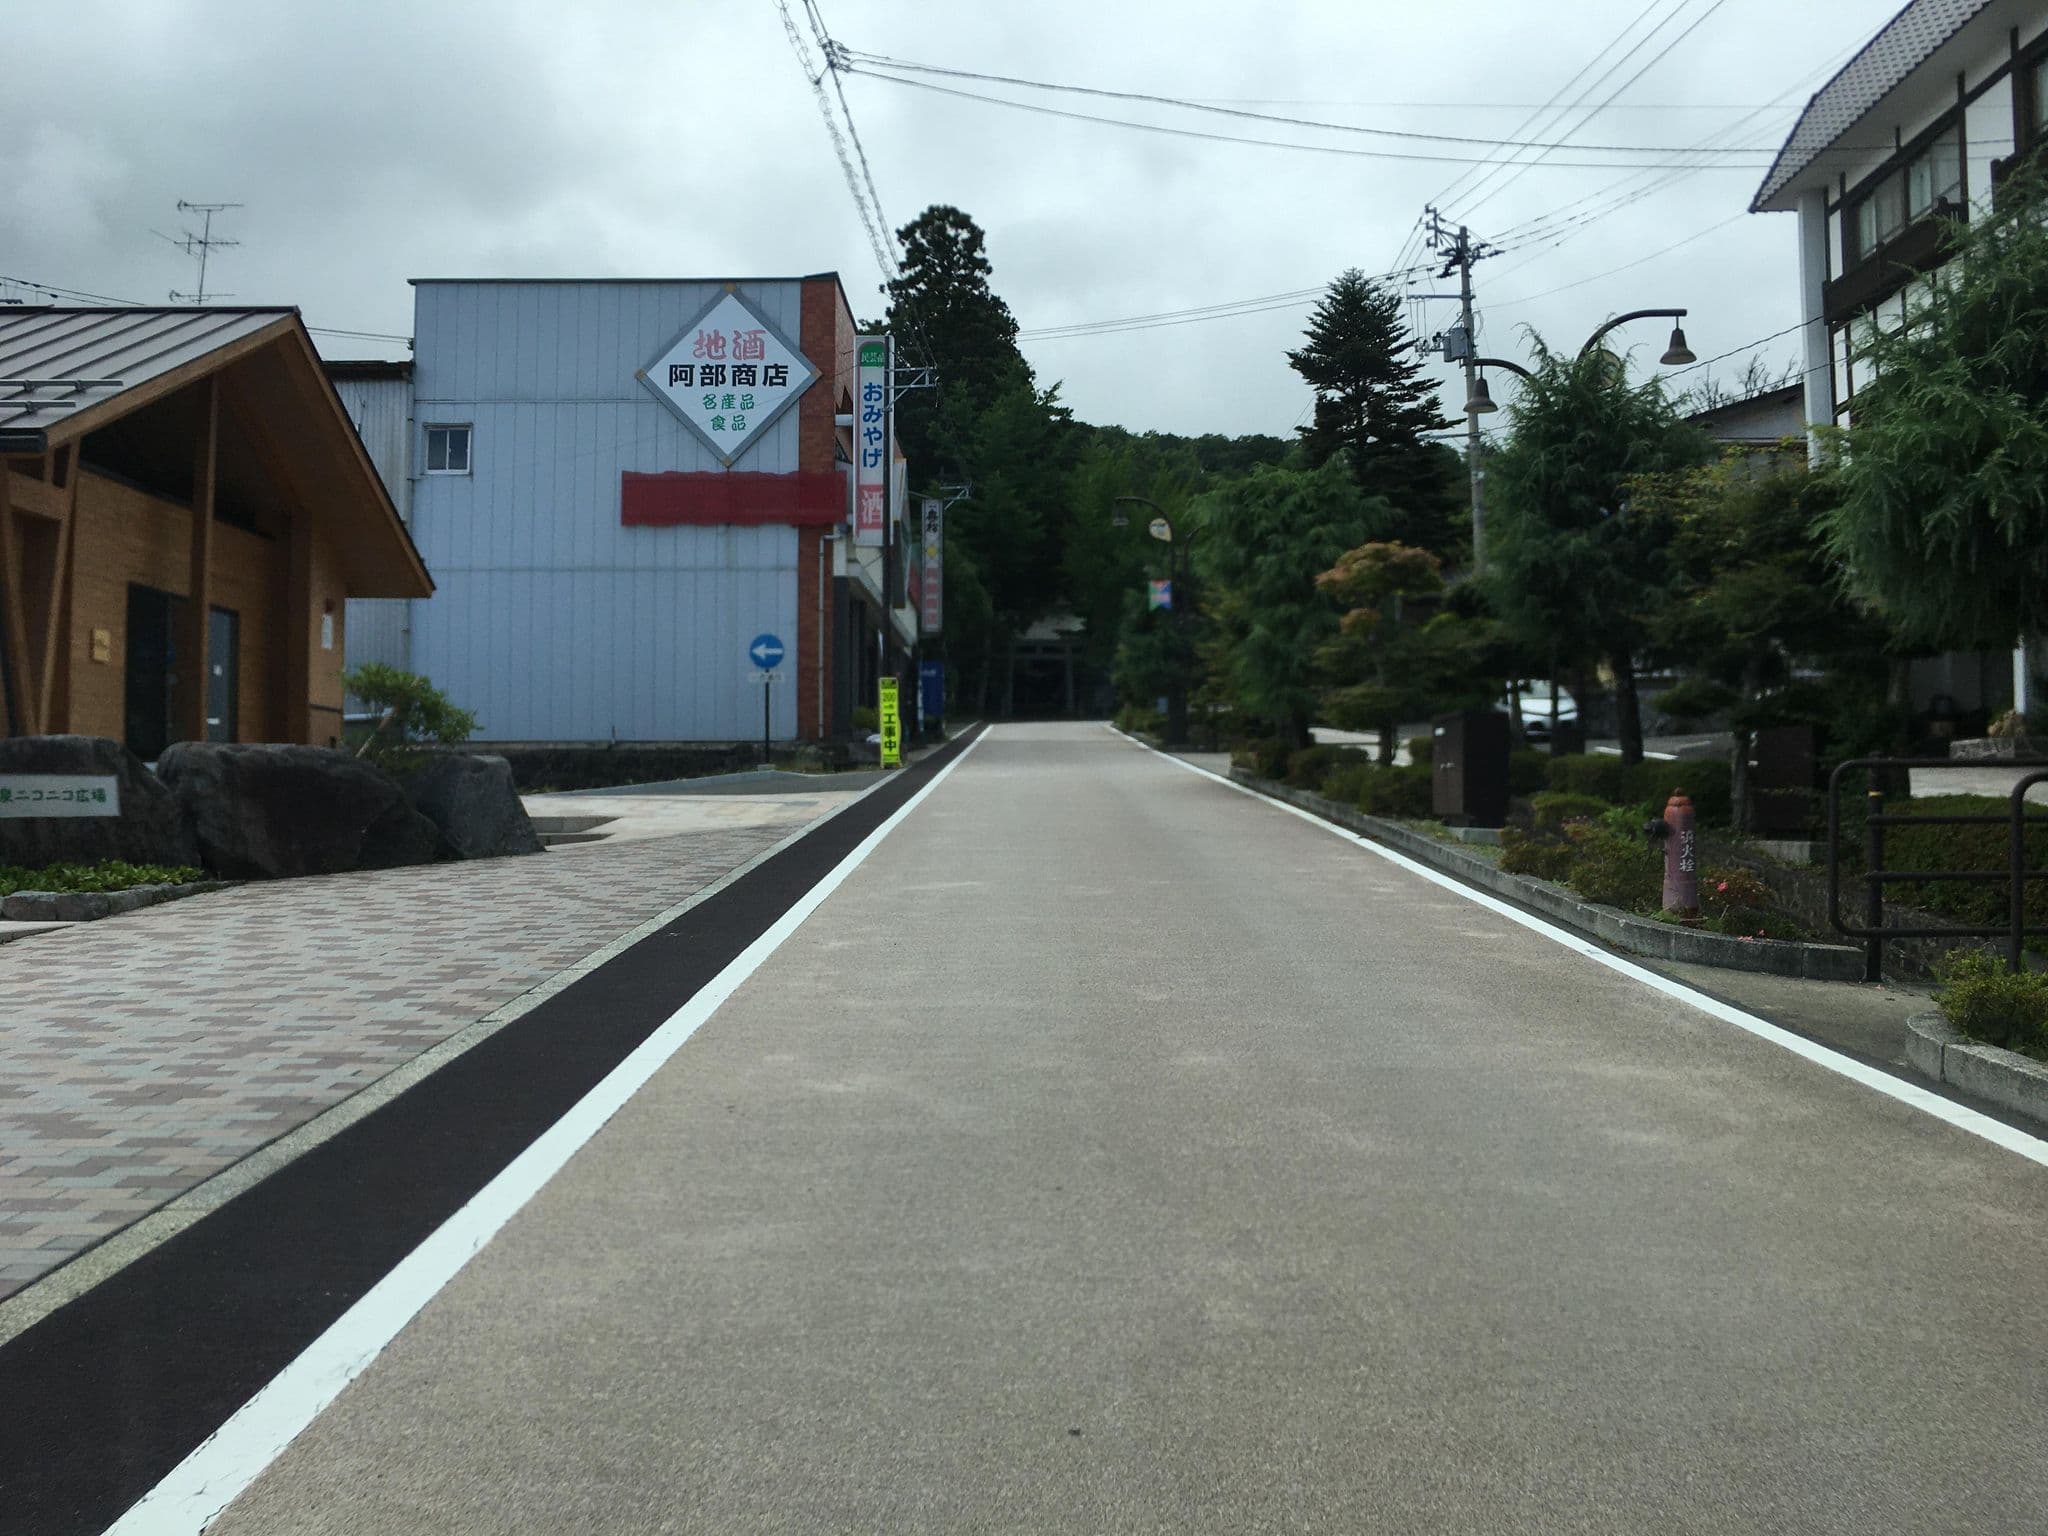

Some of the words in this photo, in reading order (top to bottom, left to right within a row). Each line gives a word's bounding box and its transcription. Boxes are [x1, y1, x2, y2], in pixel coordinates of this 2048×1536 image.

[692, 328, 767, 361] 地酒
[668, 363, 789, 388] 阿部商店
[702, 392, 756, 411] 名産品
[710, 414, 748, 432] 食品
[862, 381, 884, 469] おみやげ
[883, 712, 897, 752] 工事中
[1679, 830, 1696, 873] 消火栓
